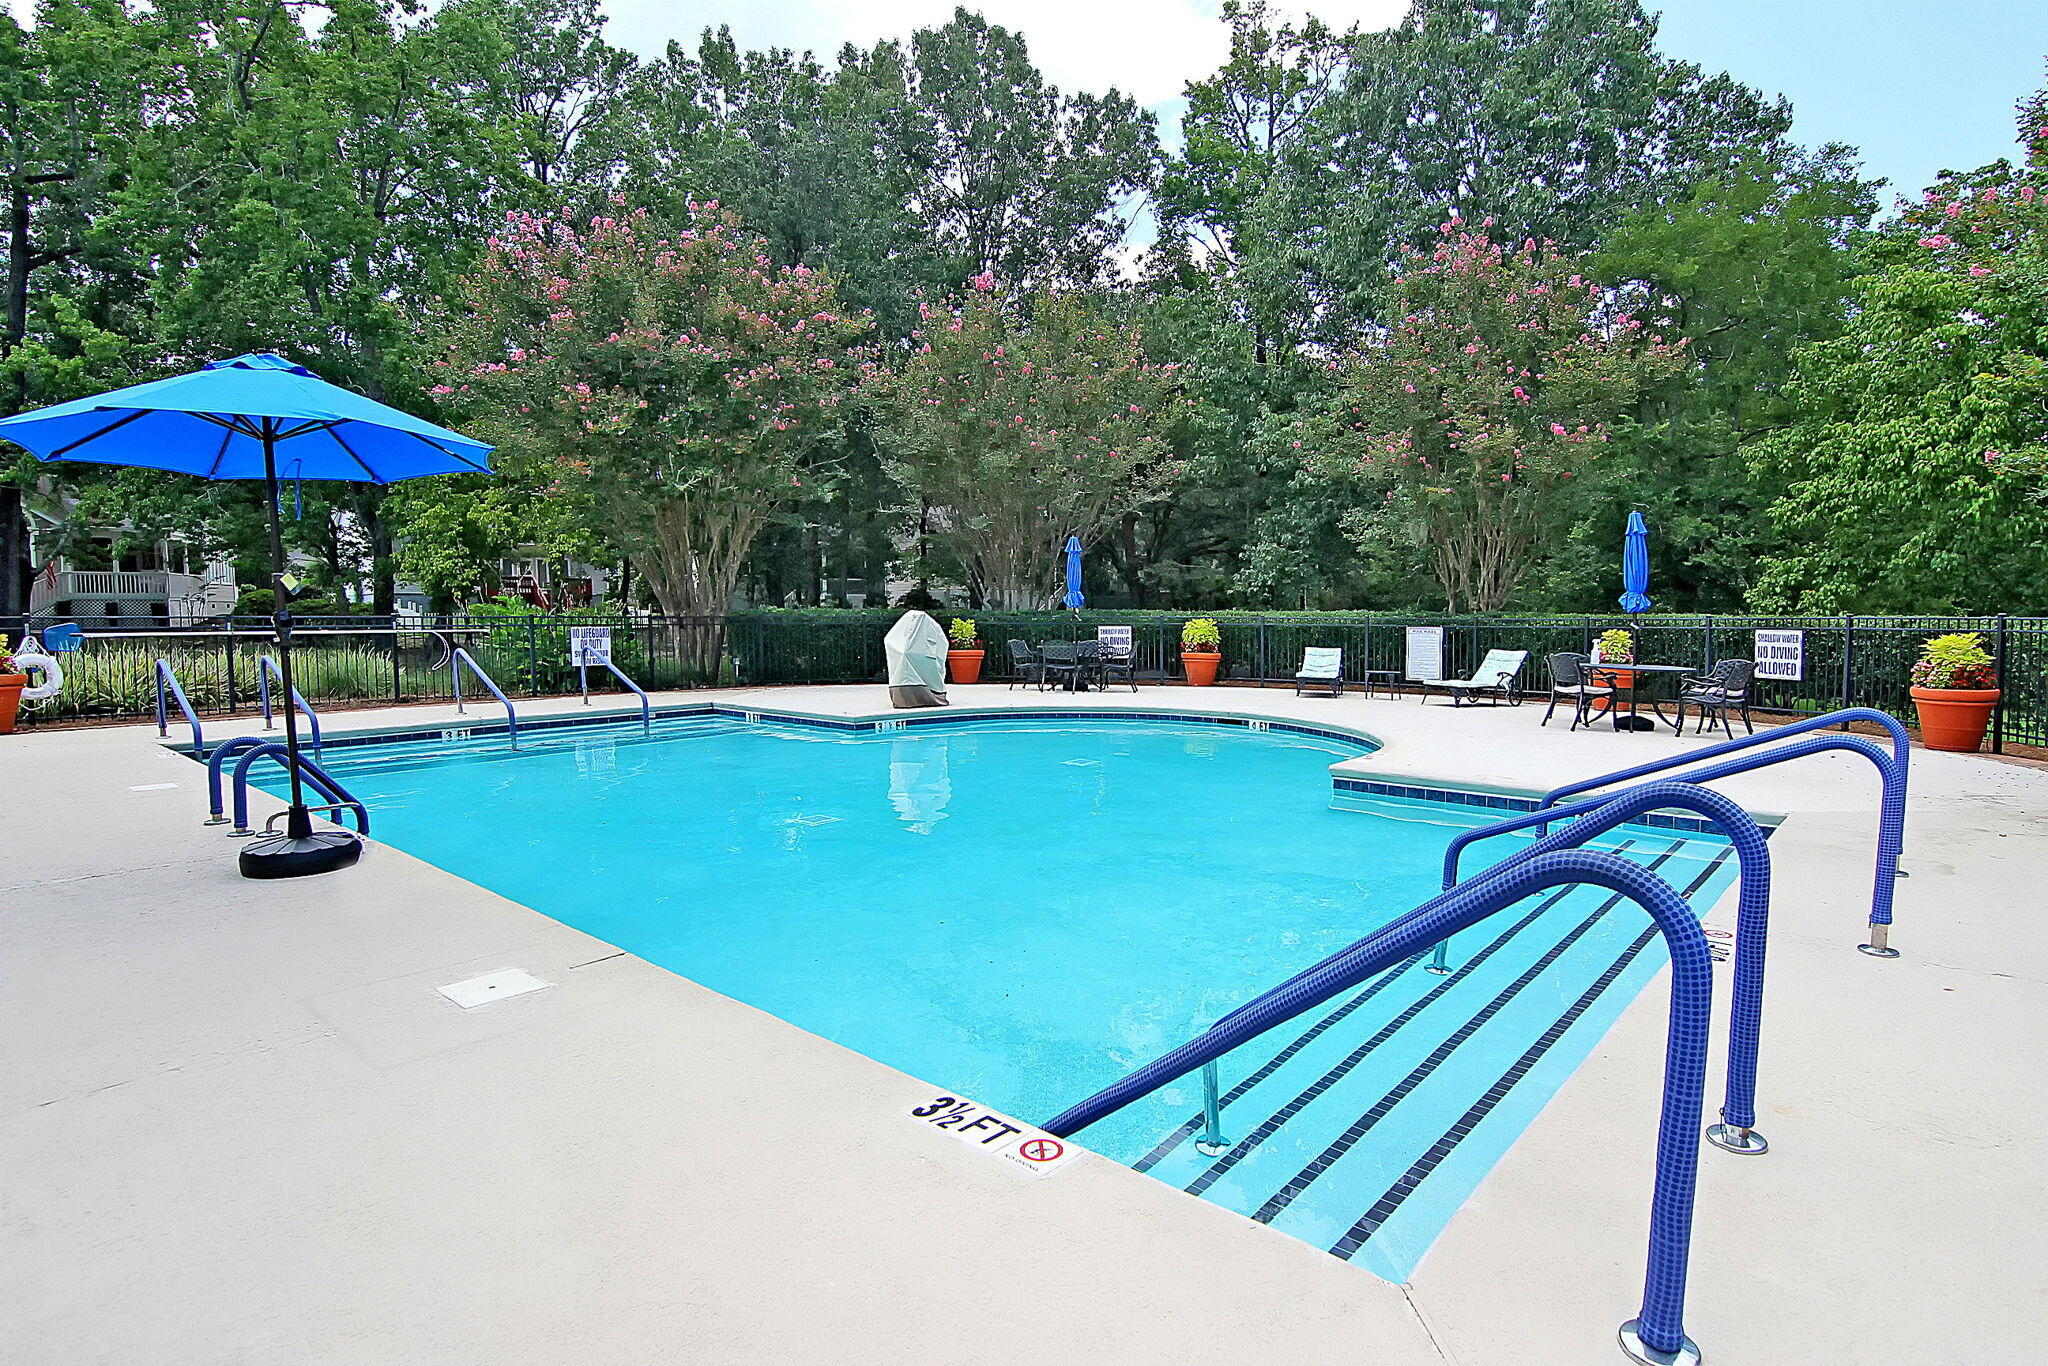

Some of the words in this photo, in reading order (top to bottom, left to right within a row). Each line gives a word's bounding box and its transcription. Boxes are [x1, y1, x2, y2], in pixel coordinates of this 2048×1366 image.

[572, 628, 580, 638] NO
[581, 628, 610, 638] LIFEGUARD
[1757, 633, 1781, 643] SHALLOW
[1782, 634, 1800, 643] WATER
[589, 639, 603, 650] DUTY
[1110, 637, 1130, 646] DIVING
[1757, 646, 1768, 659] NO
[1770, 645, 1799, 660] DIVING
[1758, 660, 1797, 676] ALLOWED
[445, 730, 453, 743] 3
[457, 729, 470, 742] FT
[957, 1115, 1022, 1144] FT
